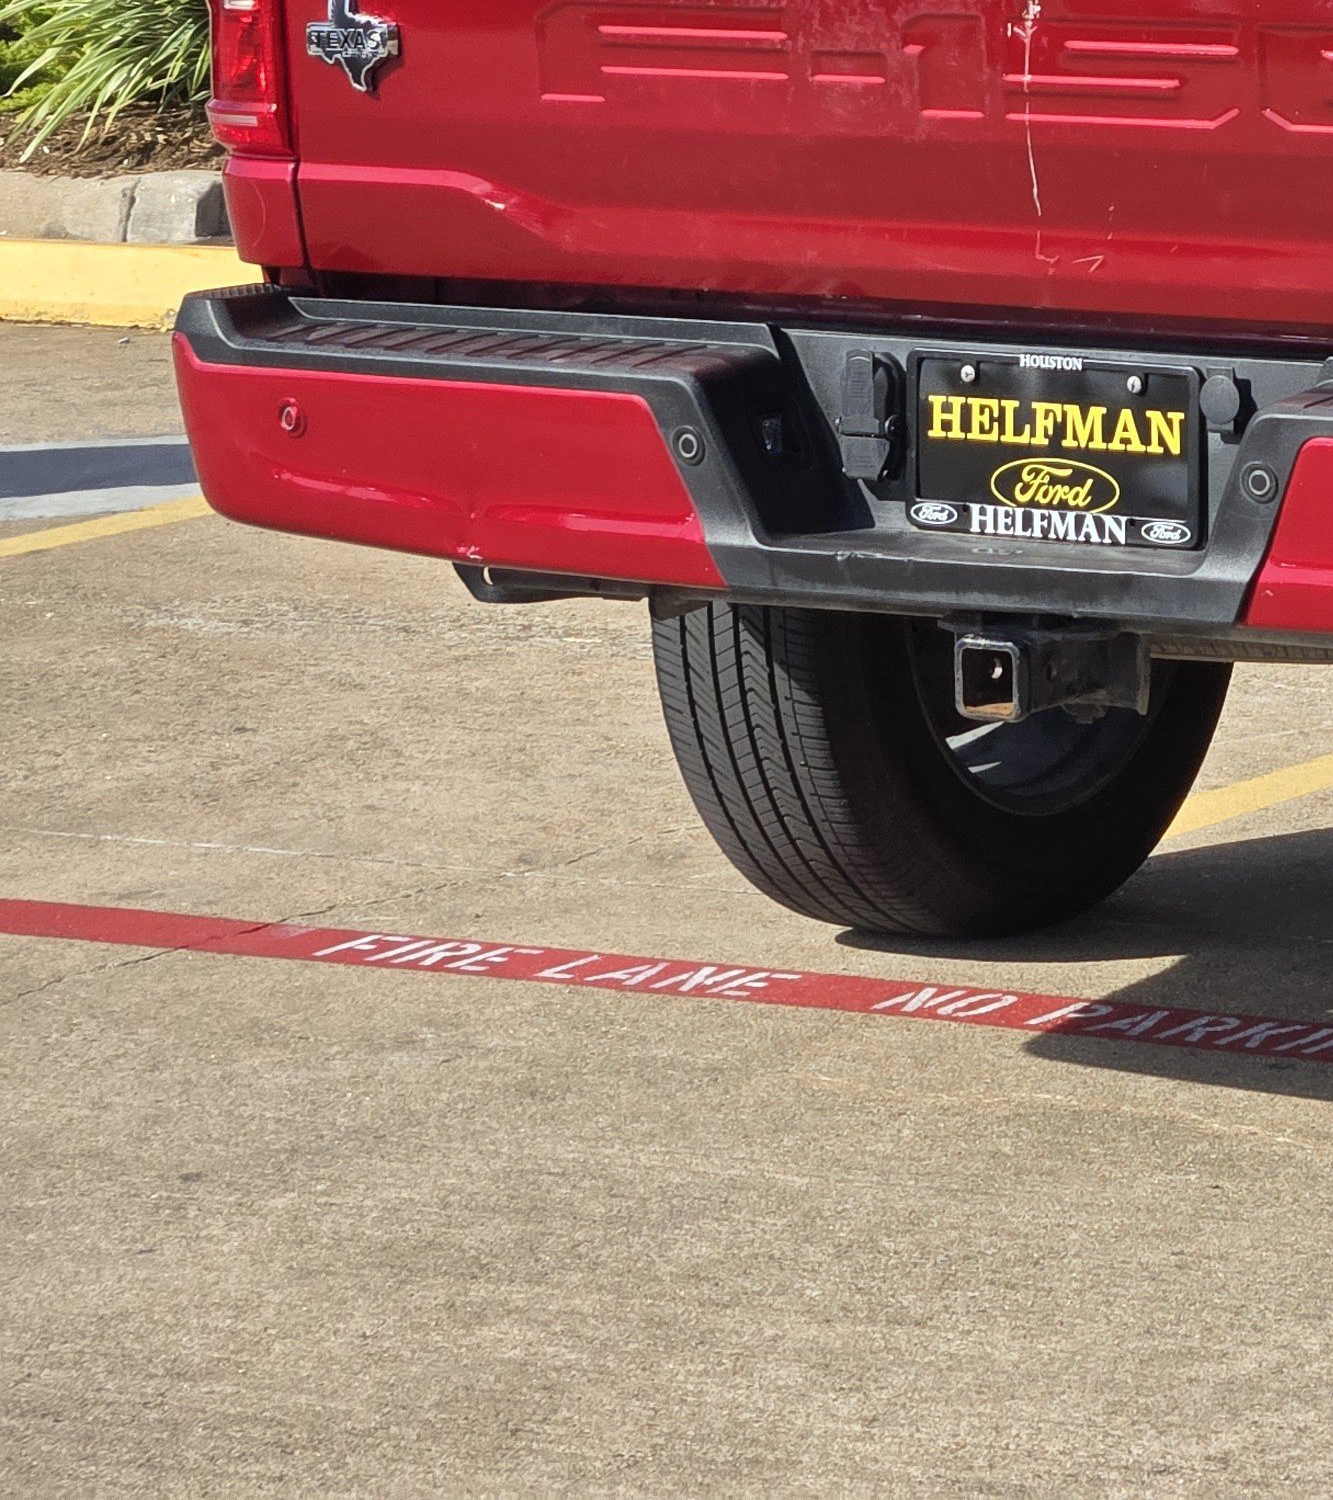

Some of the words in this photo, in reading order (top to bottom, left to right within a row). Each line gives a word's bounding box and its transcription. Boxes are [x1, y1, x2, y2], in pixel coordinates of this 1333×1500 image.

[310, 28, 383, 50] TEXAS
[1020, 354, 1083, 371] HOUSTON
[928, 395, 1185, 455] HELFMAN
[1014, 464, 1094, 507] Ford
[919, 505, 949, 522] Ford
[970, 504, 1126, 544] HELFMAN
[1150, 525, 1181, 542] Ford
[313, 934, 544, 971] FIRE
[535, 955, 801, 997] LANE
[872, 987, 1018, 1017] NO
